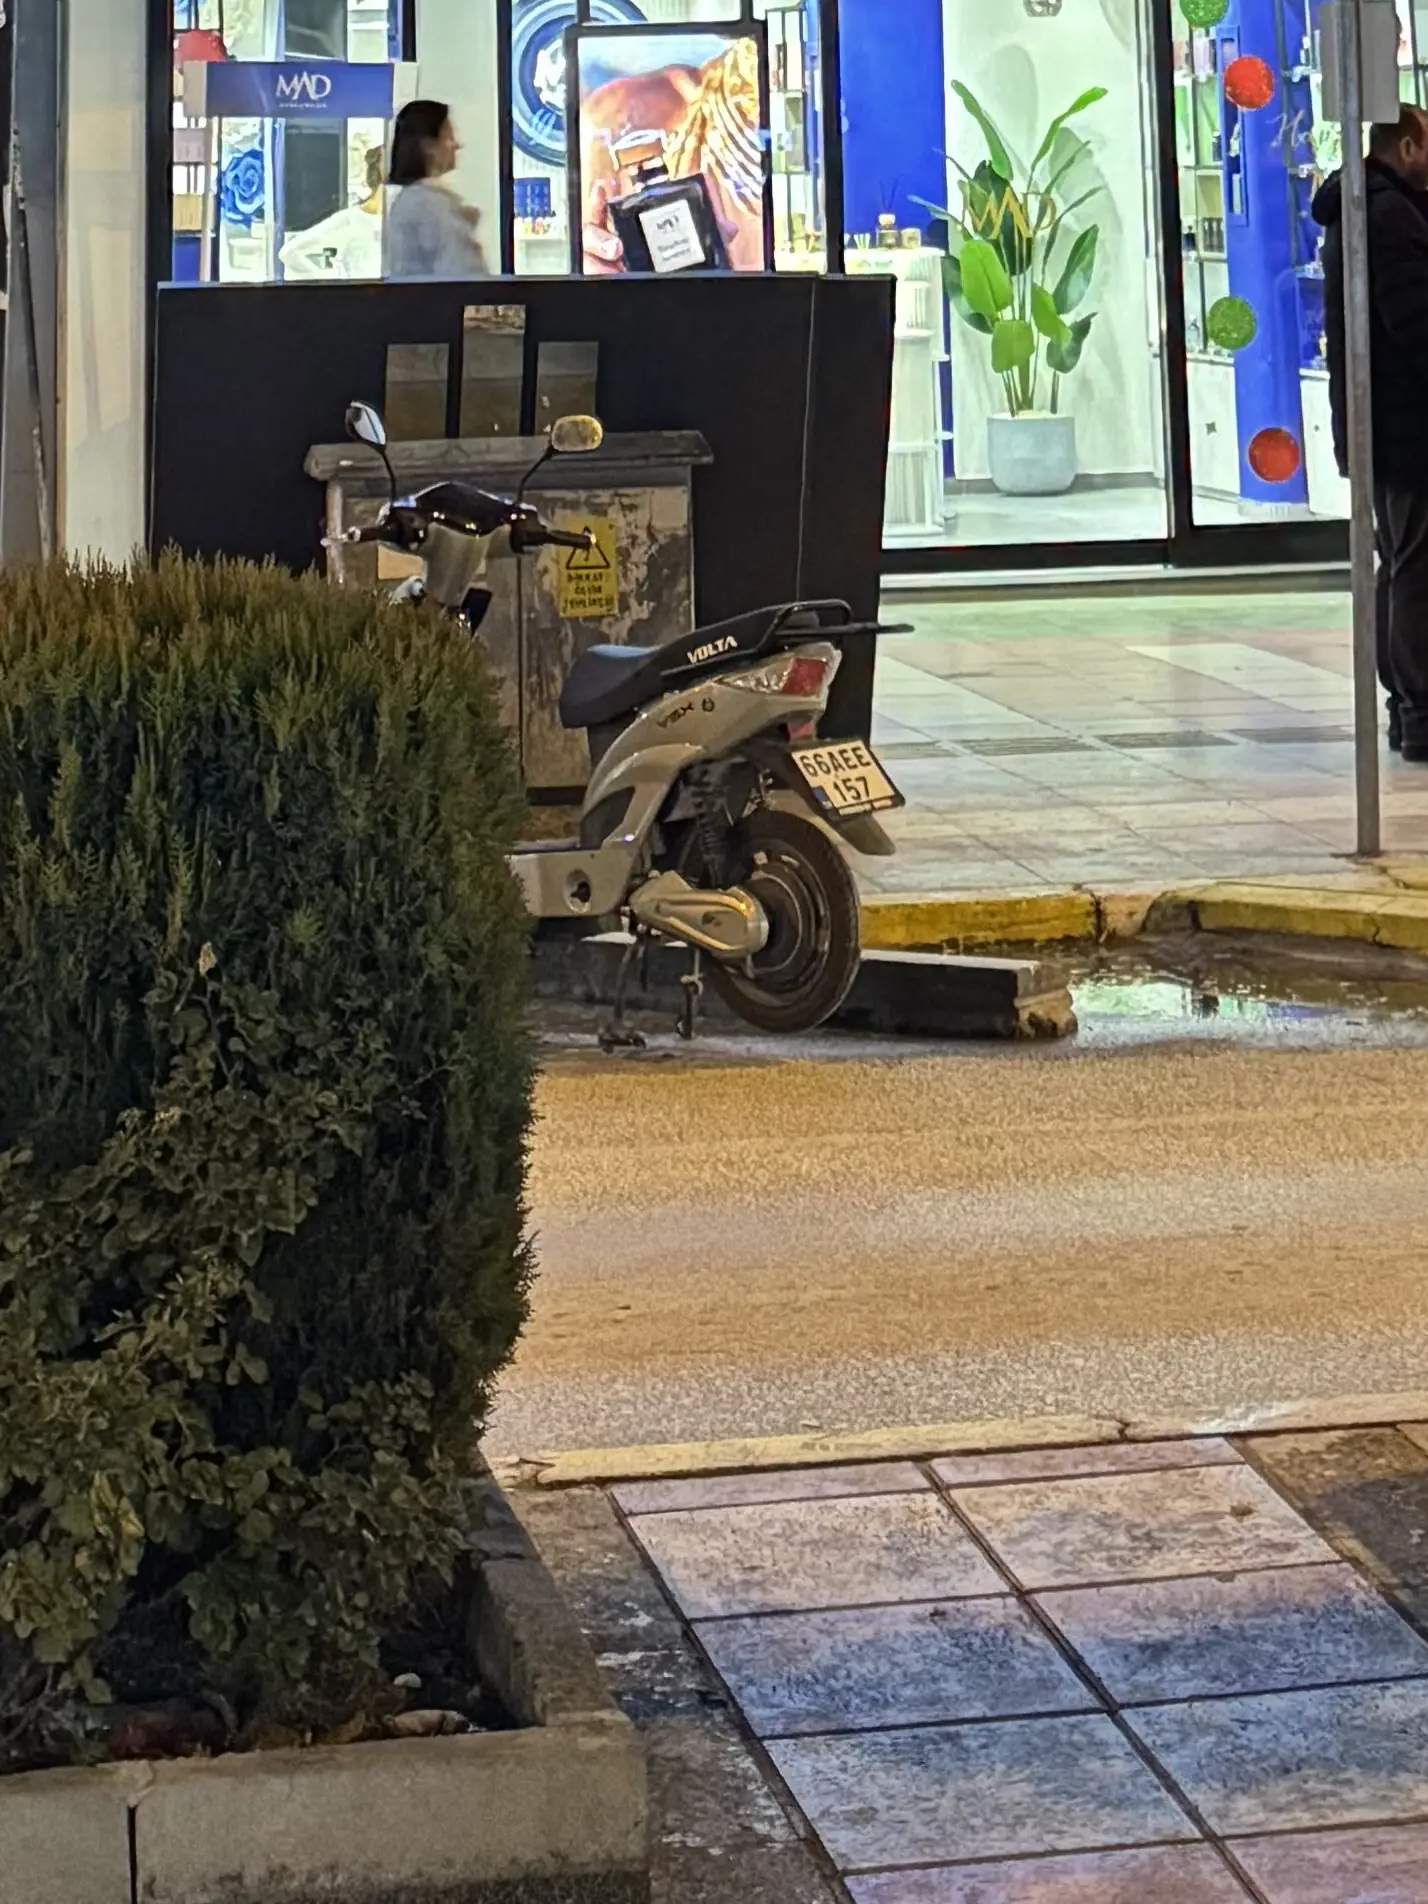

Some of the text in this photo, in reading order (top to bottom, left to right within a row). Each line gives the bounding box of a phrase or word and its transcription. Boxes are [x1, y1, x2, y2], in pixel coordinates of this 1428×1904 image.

[275, 70, 332, 101] MAD
[686, 634, 738, 664] VOLTA
[799, 745, 872, 779] 66AEE
[832, 775, 871, 804] 157
